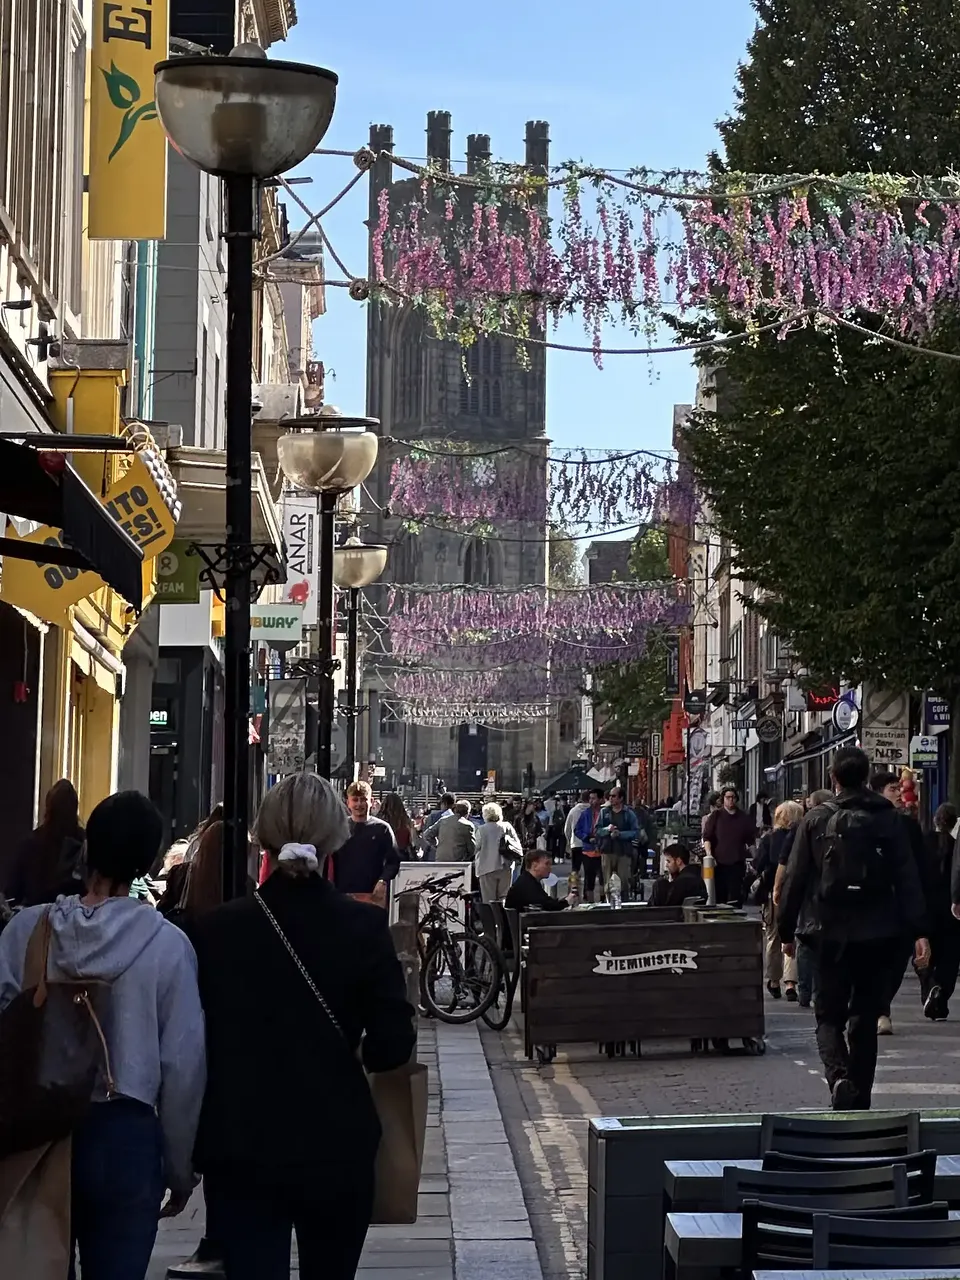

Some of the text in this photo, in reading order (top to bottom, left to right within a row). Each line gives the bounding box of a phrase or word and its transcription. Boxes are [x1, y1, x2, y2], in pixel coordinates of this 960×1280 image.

[289, 513, 307, 575] ANAR
[157, 582, 184, 593] XFAM
[251, 617, 298, 628] BWAY
[932, 705, 948, 713] COFF
[150, 709, 168, 721] pen
[865, 731, 906, 739] Pedestrian
[606, 953, 688, 971] PIEMINISTER
